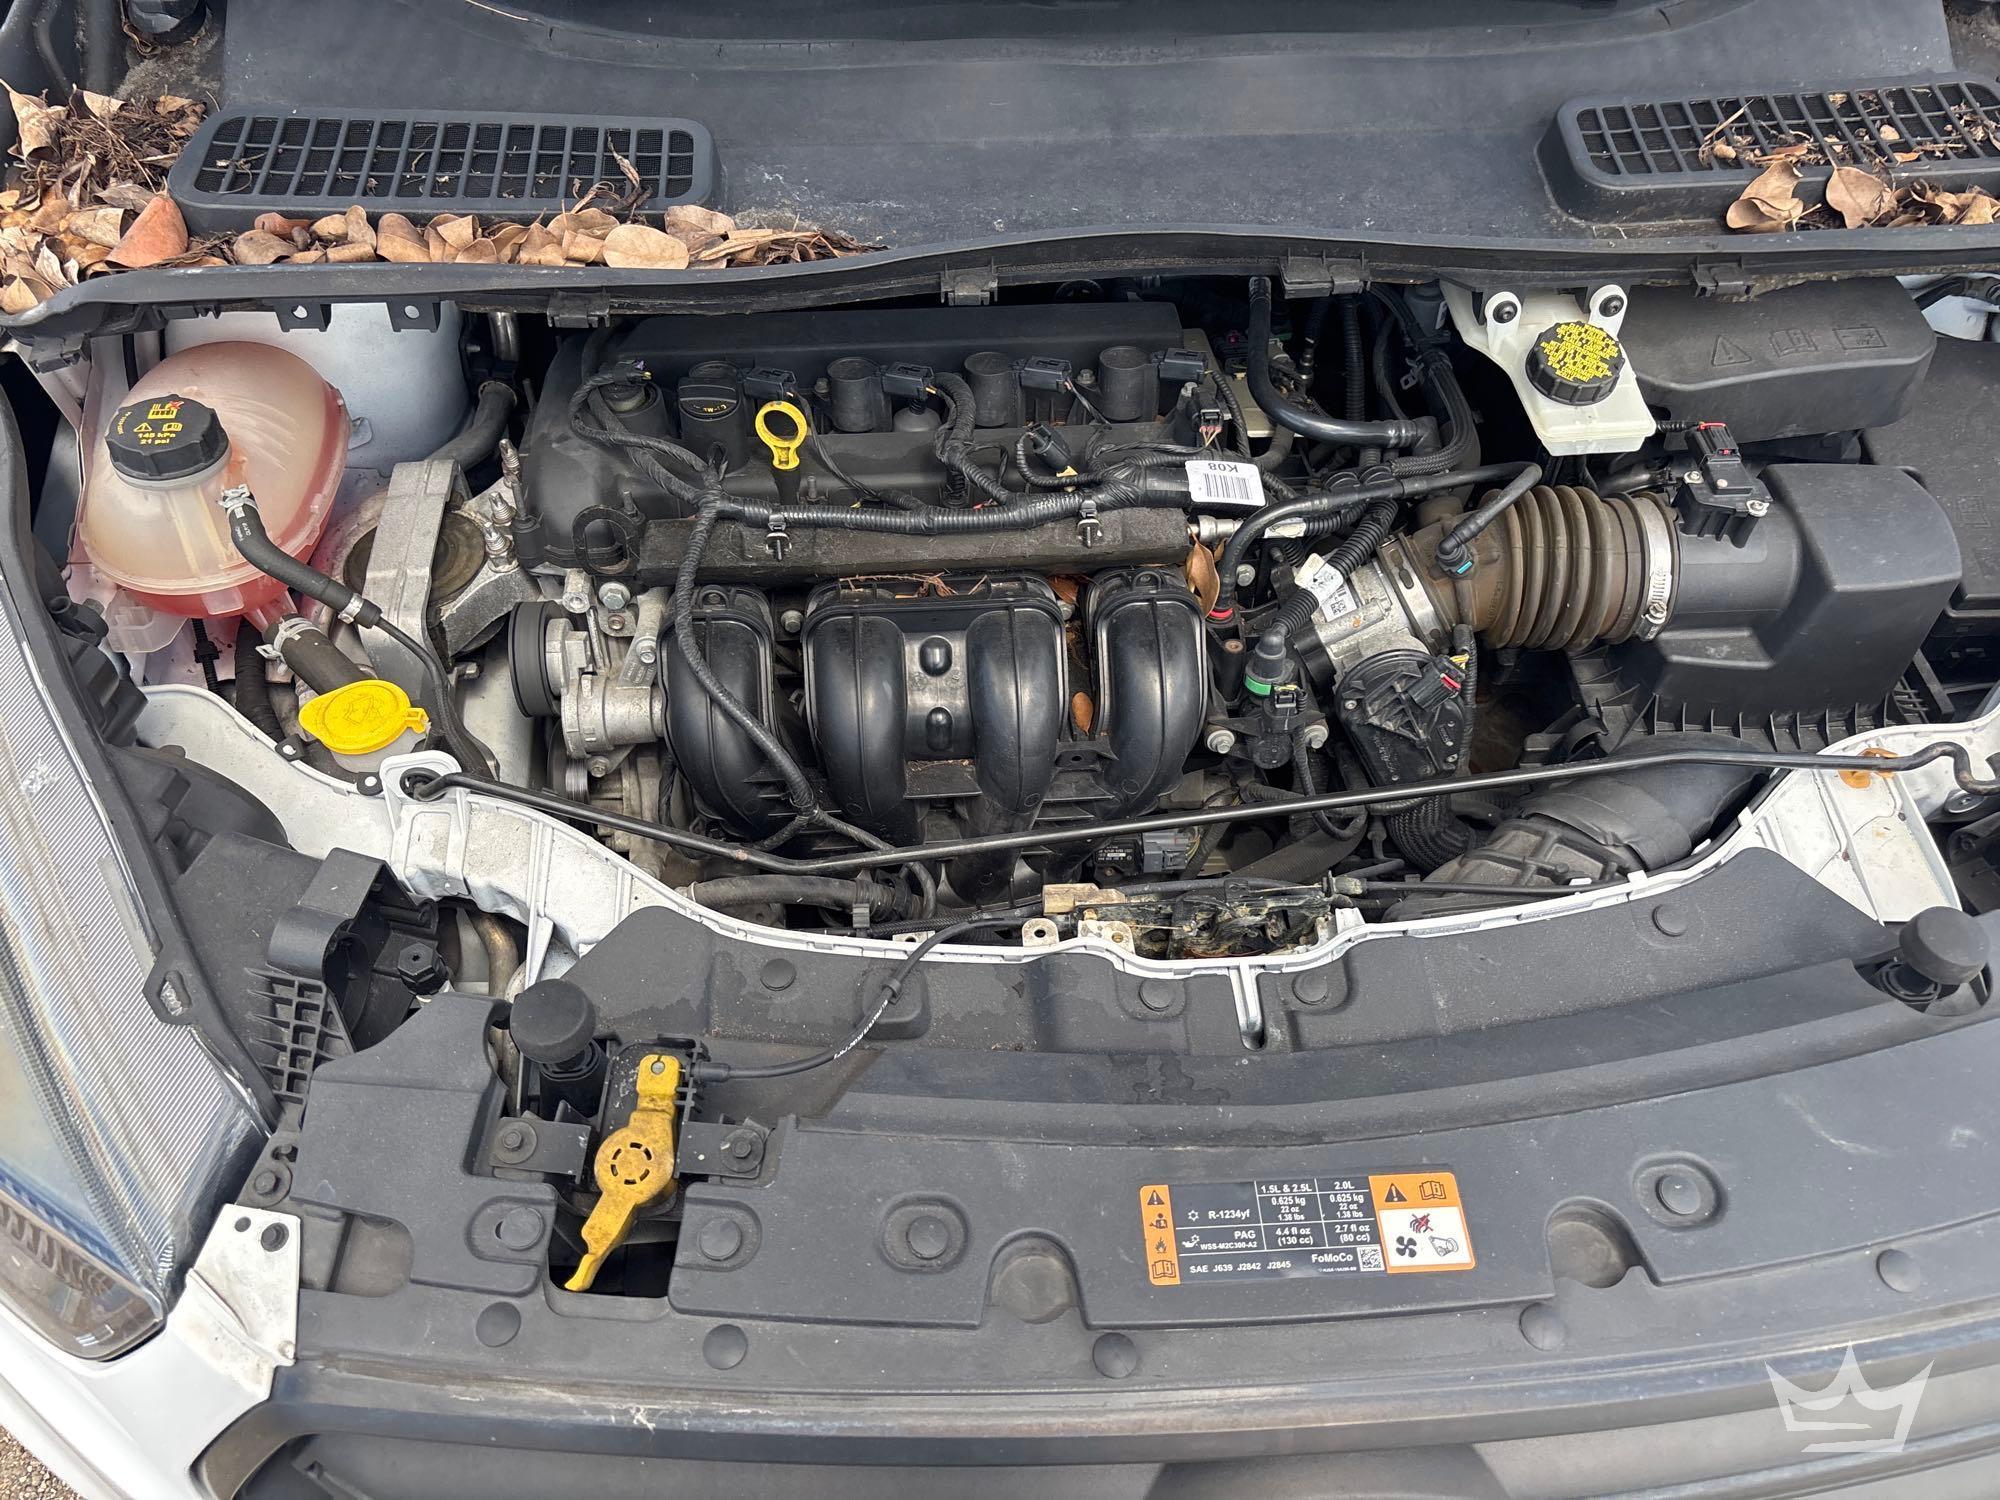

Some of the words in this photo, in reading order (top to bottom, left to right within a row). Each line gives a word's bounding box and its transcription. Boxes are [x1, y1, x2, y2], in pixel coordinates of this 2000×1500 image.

[1208, 462, 1238, 473] K08
[1261, 1184, 1280, 1194] 1.5L
[1282, 1184, 1290, 1192] &
[1292, 1183, 1312, 1192] 2.5L
[1334, 1181, 1355, 1190] 2.0L
[1271, 1196, 1294, 1206] 0.625
[1295, 1196, 1306, 1206] kg
[1330, 1194, 1352, 1203] 0.625
[1353, 1194, 1364, 1203] kg
[1208, 1208, 1250, 1220] R-1234yf
[1276, 1227, 1290, 1236] 4.4
[1290, 1226, 1298, 1234] fl
[1335, 1225, 1348, 1233] 2.7
[1234, 1230, 1256, 1240] PAG
[1340, 1234, 1354, 1244] (80
[1356, 1233, 1370, 1243] cc)
[1278, 1237, 1298, 1246] (130
[1299, 1236, 1314, 1246] cc)
[1311, 1252, 1354, 1263] FoMoCo
[1190, 1264, 1209, 1274] SAE
[1212, 1264, 1233, 1272] J639
[1236, 1262, 1262, 1272] J2842
[1267, 1260, 1292, 1270] J2845
